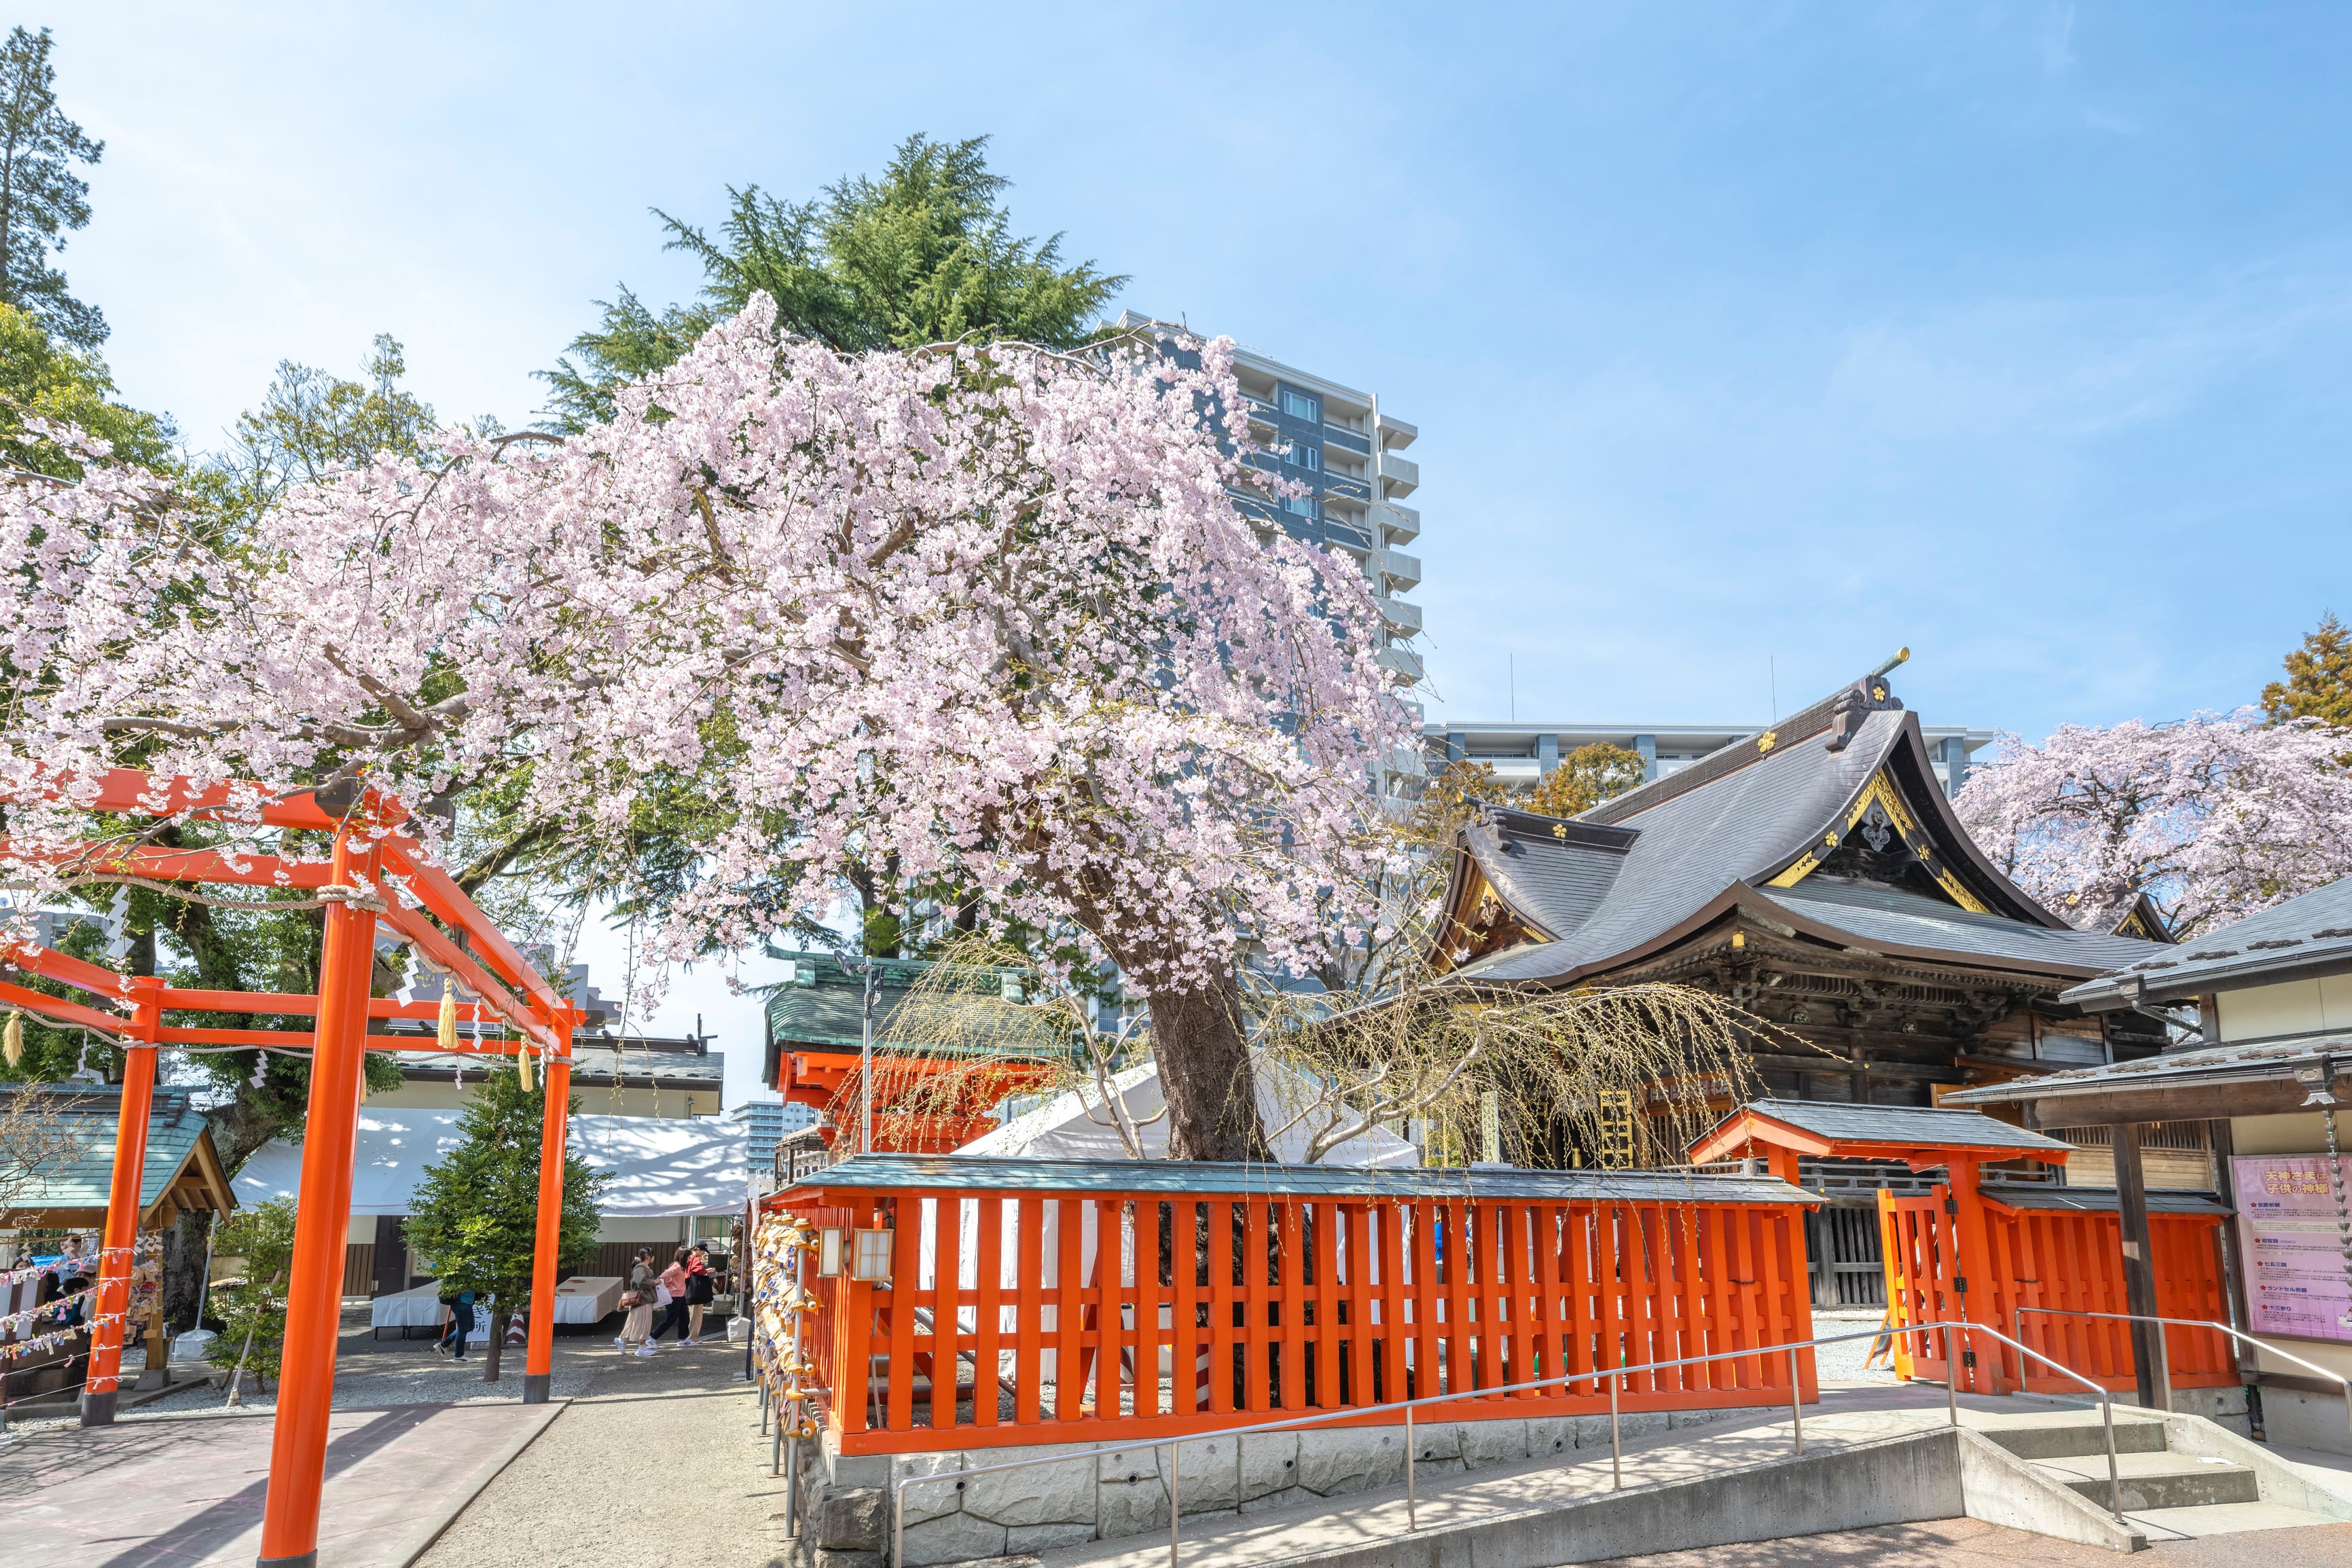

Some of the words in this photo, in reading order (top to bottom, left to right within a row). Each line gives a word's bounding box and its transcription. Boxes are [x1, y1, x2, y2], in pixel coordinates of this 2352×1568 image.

[2265, 1171, 2328, 1182] 天神さまは
[2266, 1183, 2330, 1195] 子供の神様
